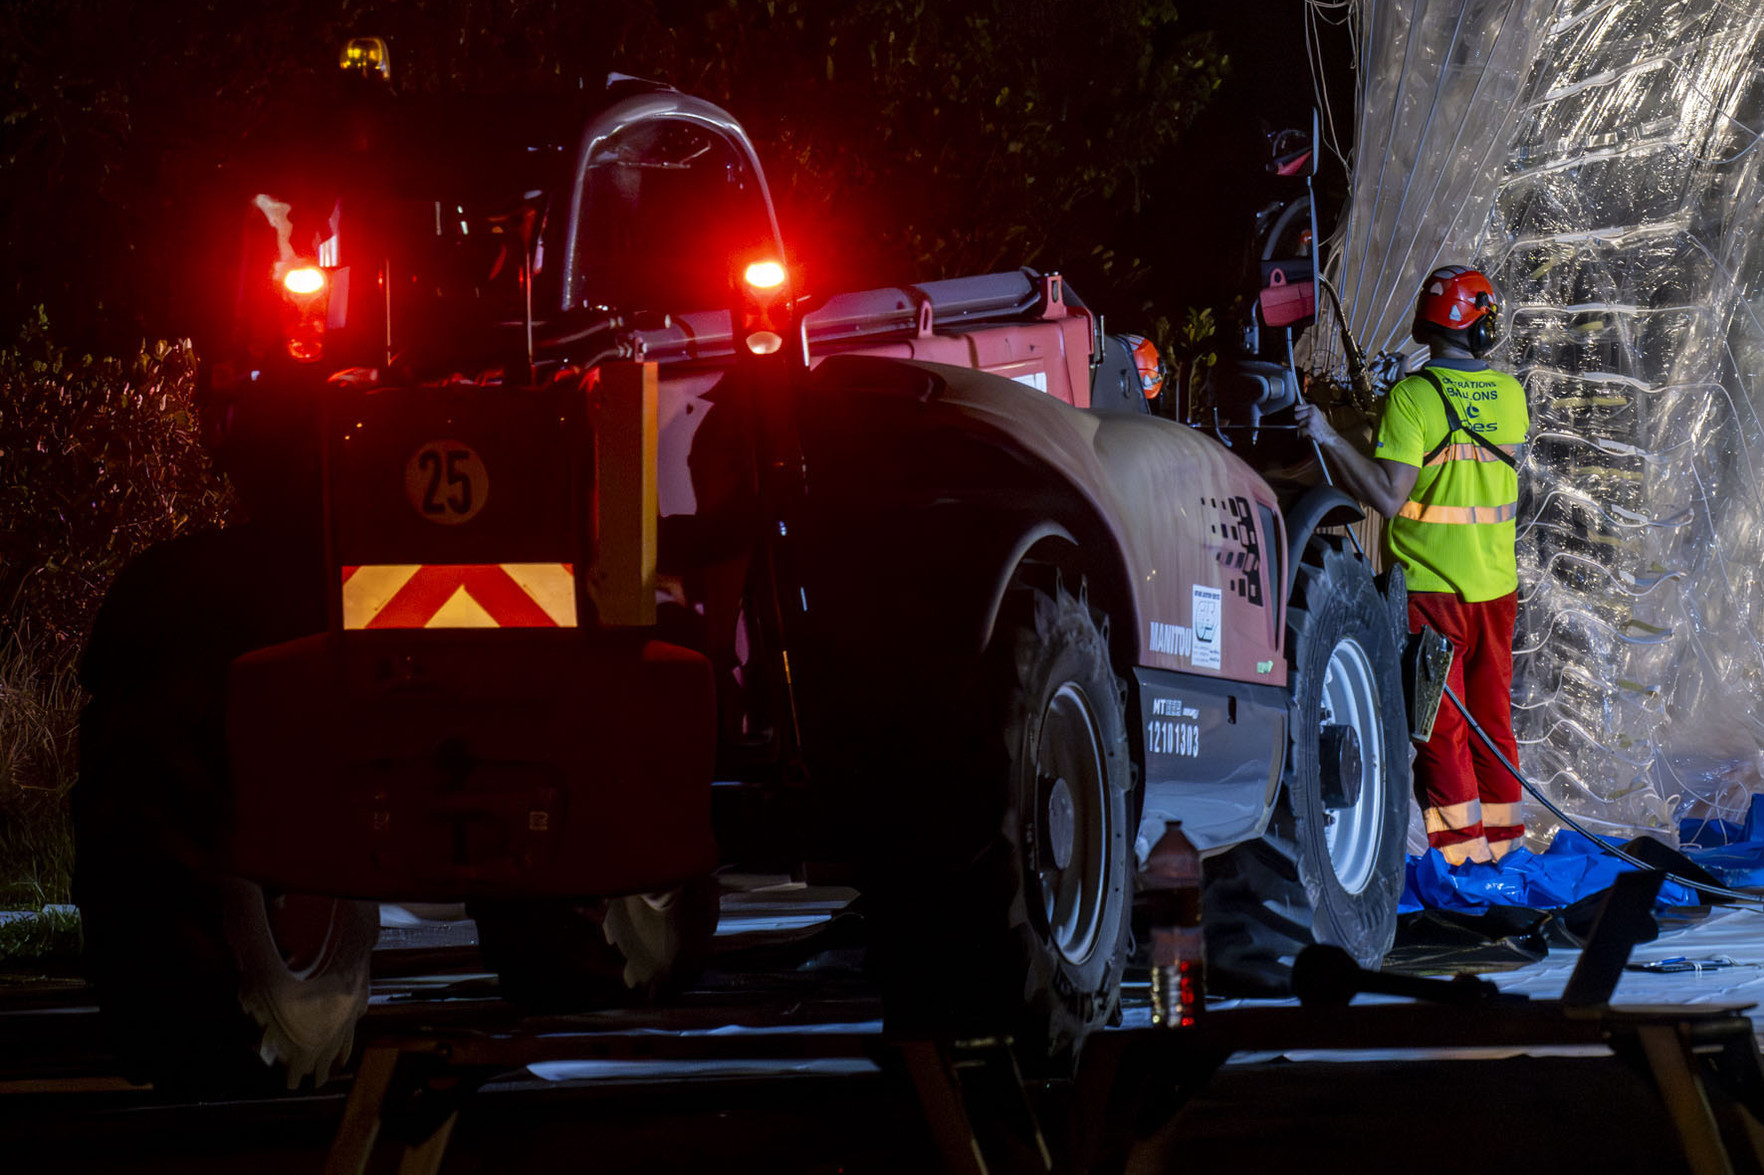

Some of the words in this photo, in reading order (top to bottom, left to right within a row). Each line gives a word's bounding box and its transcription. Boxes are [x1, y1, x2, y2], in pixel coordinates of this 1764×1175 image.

[419, 449, 472, 514] 25
[1149, 621, 1193, 658] MANITOU
[1148, 720, 1199, 758] 12101303
